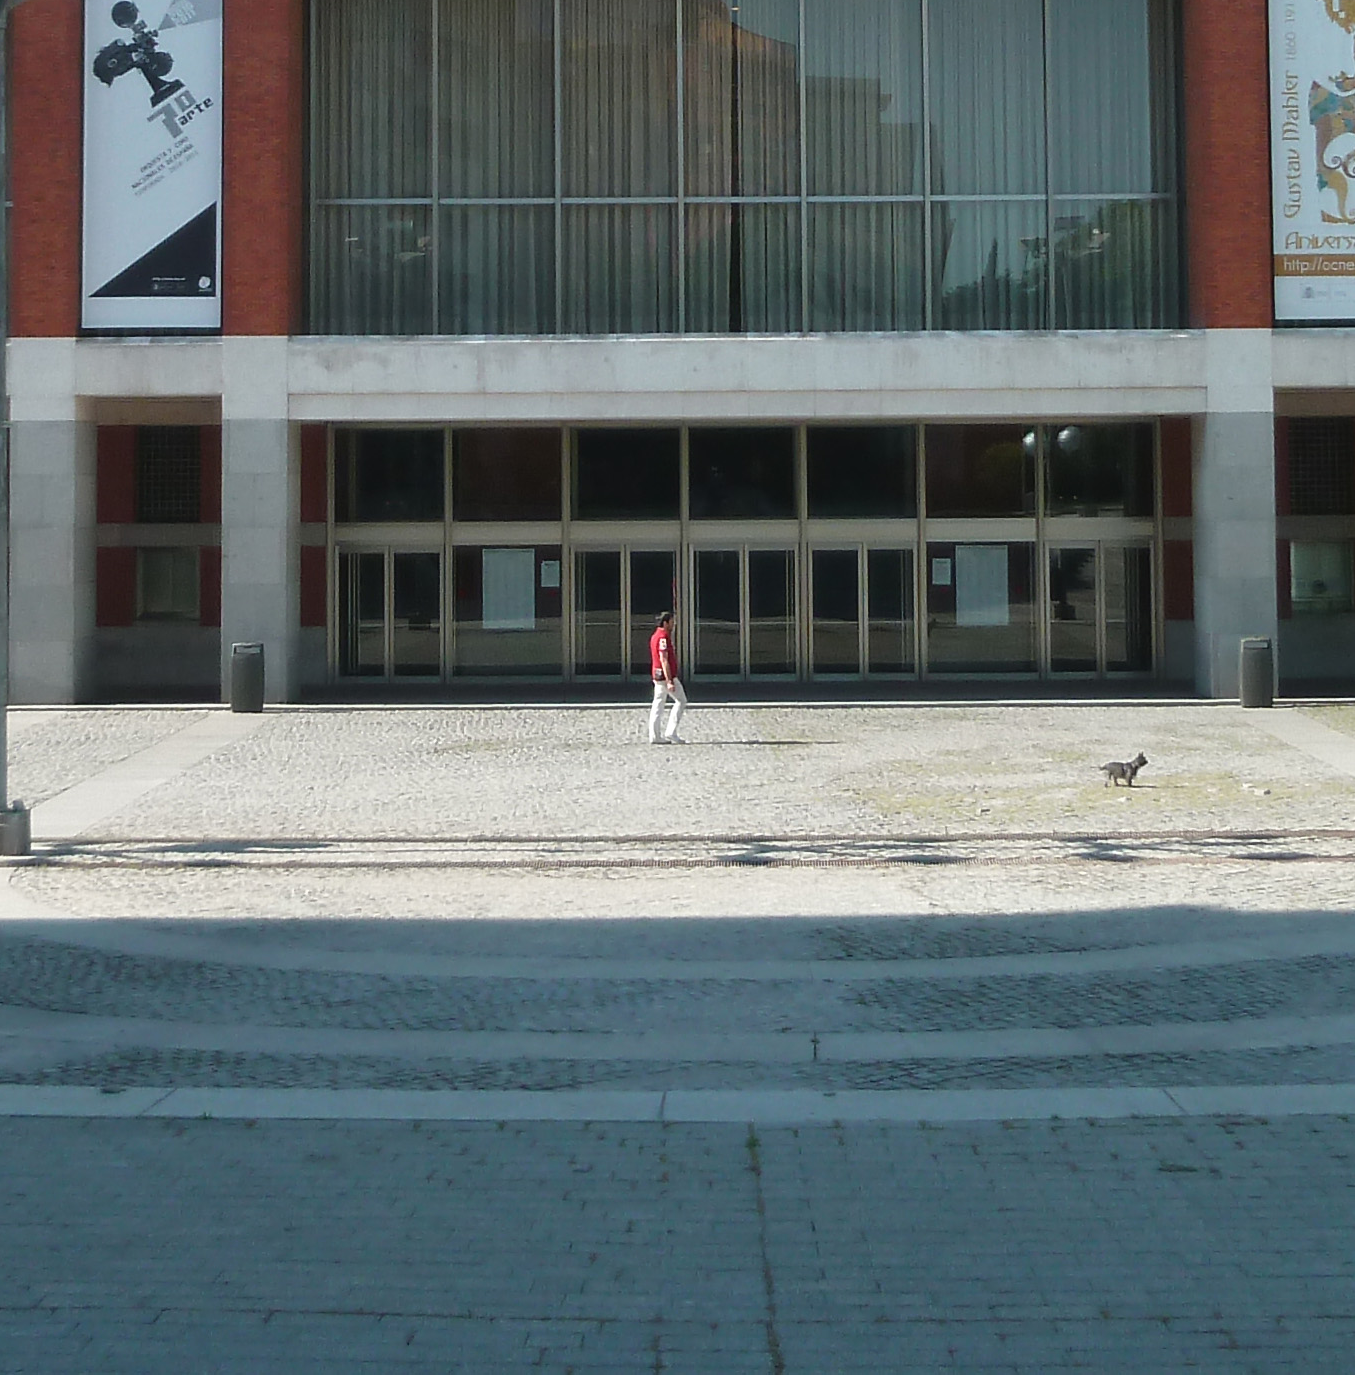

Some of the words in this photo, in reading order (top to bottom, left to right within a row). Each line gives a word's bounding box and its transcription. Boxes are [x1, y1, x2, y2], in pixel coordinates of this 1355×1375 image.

[178, 97, 214, 126] arte
[1281, 70, 1300, 142] Mahler
[1283, 149, 1302, 219] Gustav
